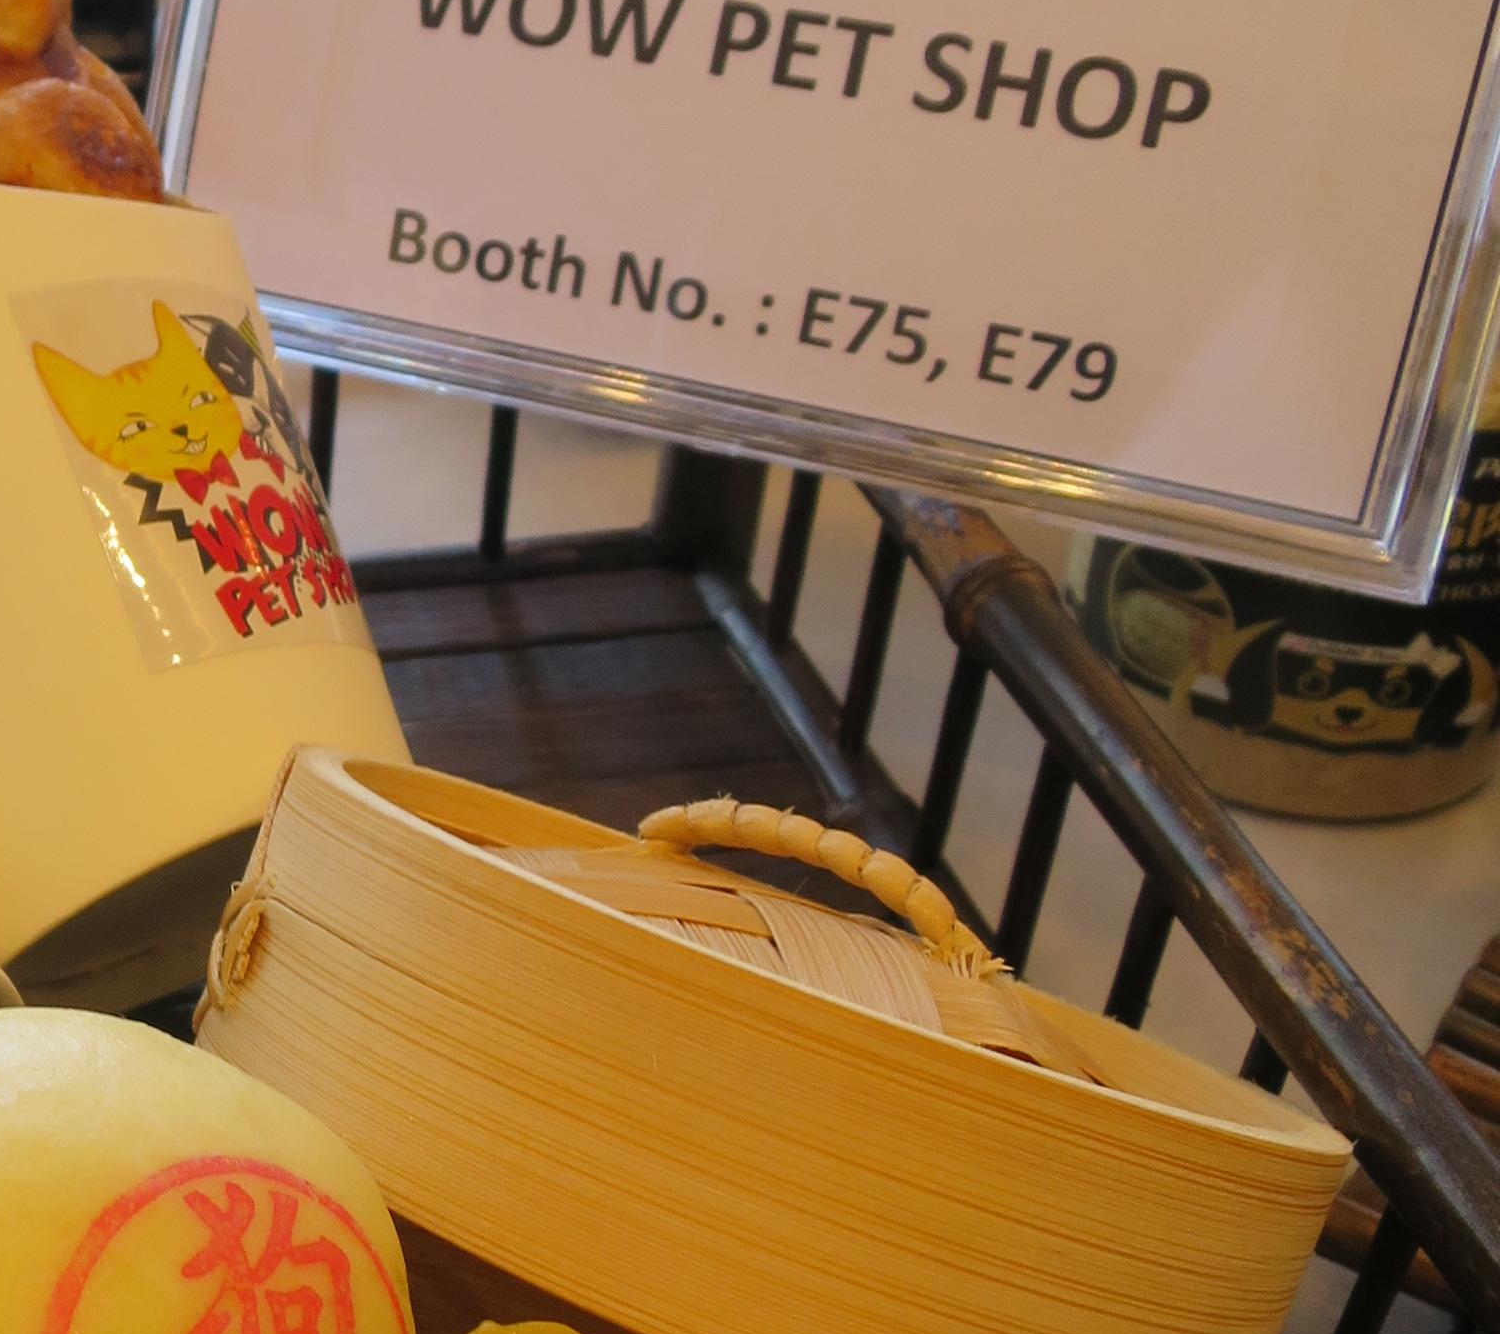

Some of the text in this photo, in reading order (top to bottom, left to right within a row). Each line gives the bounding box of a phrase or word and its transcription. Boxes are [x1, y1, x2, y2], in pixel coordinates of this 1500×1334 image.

[911, 32, 1213, 150] SHOP
[387, 208, 586, 299] Booth
[798, 287, 950, 384] E75,
[977, 322, 1120, 404] E79
[191, 480, 331, 574] WOW
[215, 562, 303, 638] PET
